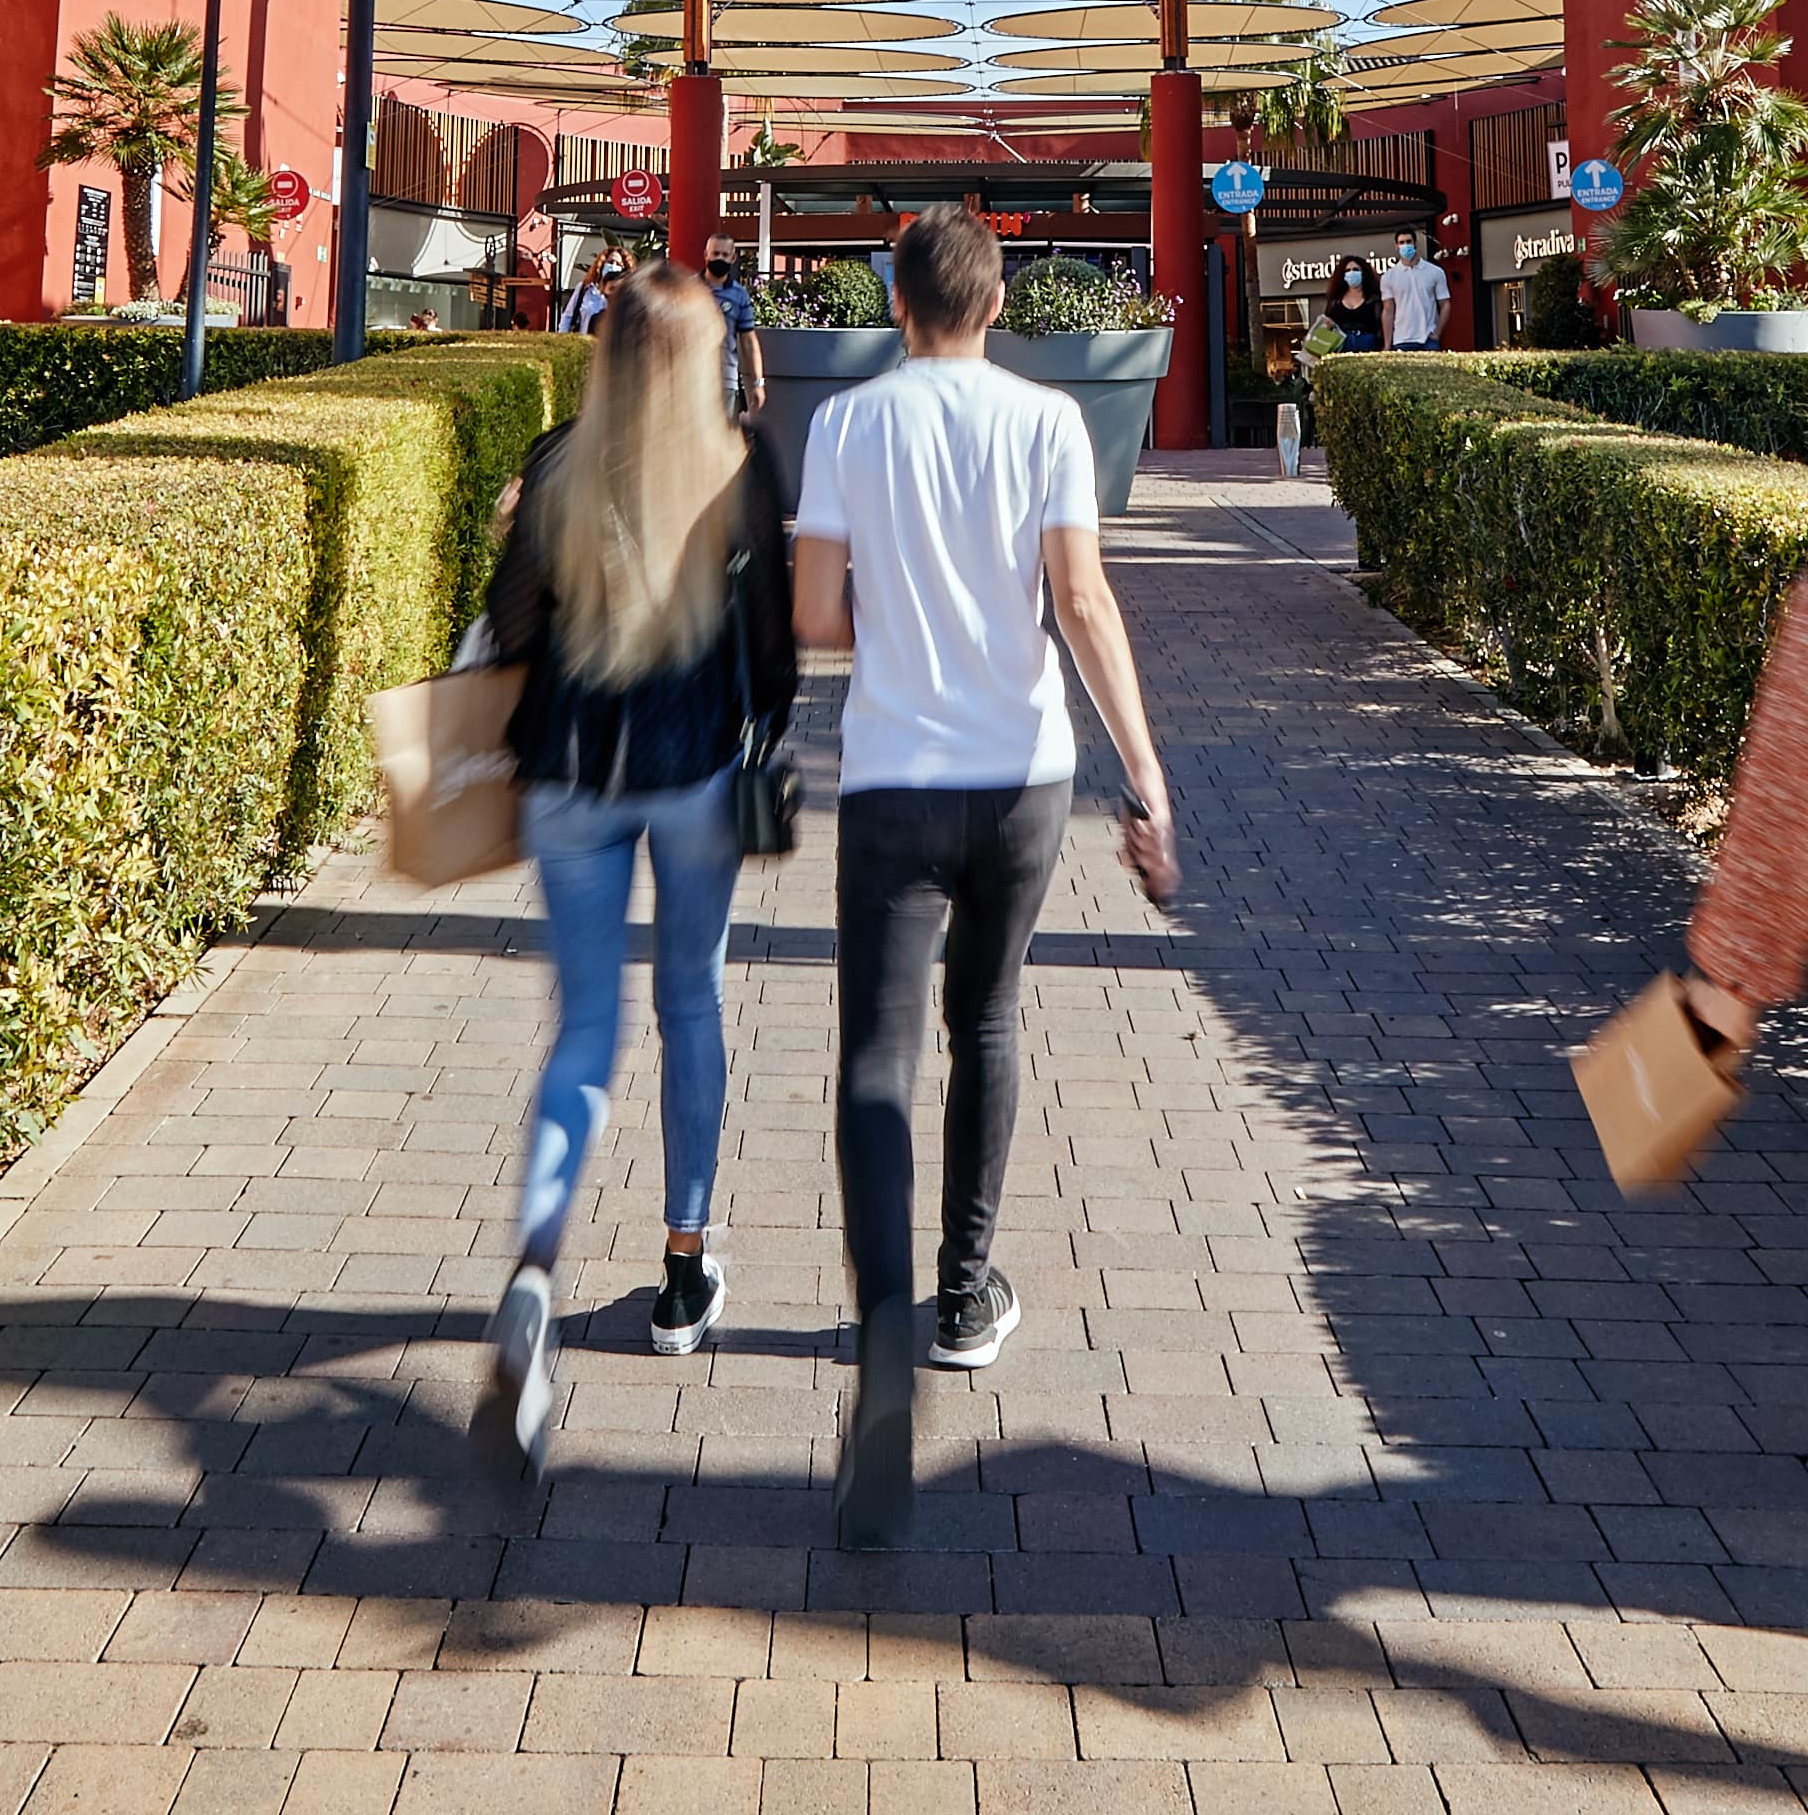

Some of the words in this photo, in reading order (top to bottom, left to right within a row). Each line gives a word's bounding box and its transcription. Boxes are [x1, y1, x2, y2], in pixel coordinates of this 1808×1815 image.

[1217, 189, 1259, 200] ENTRADA
[1577, 187, 1618, 197] ENTRADA
[621, 196, 653, 206] SALIDA
[1581, 195, 1616, 204] ENTRANCE
